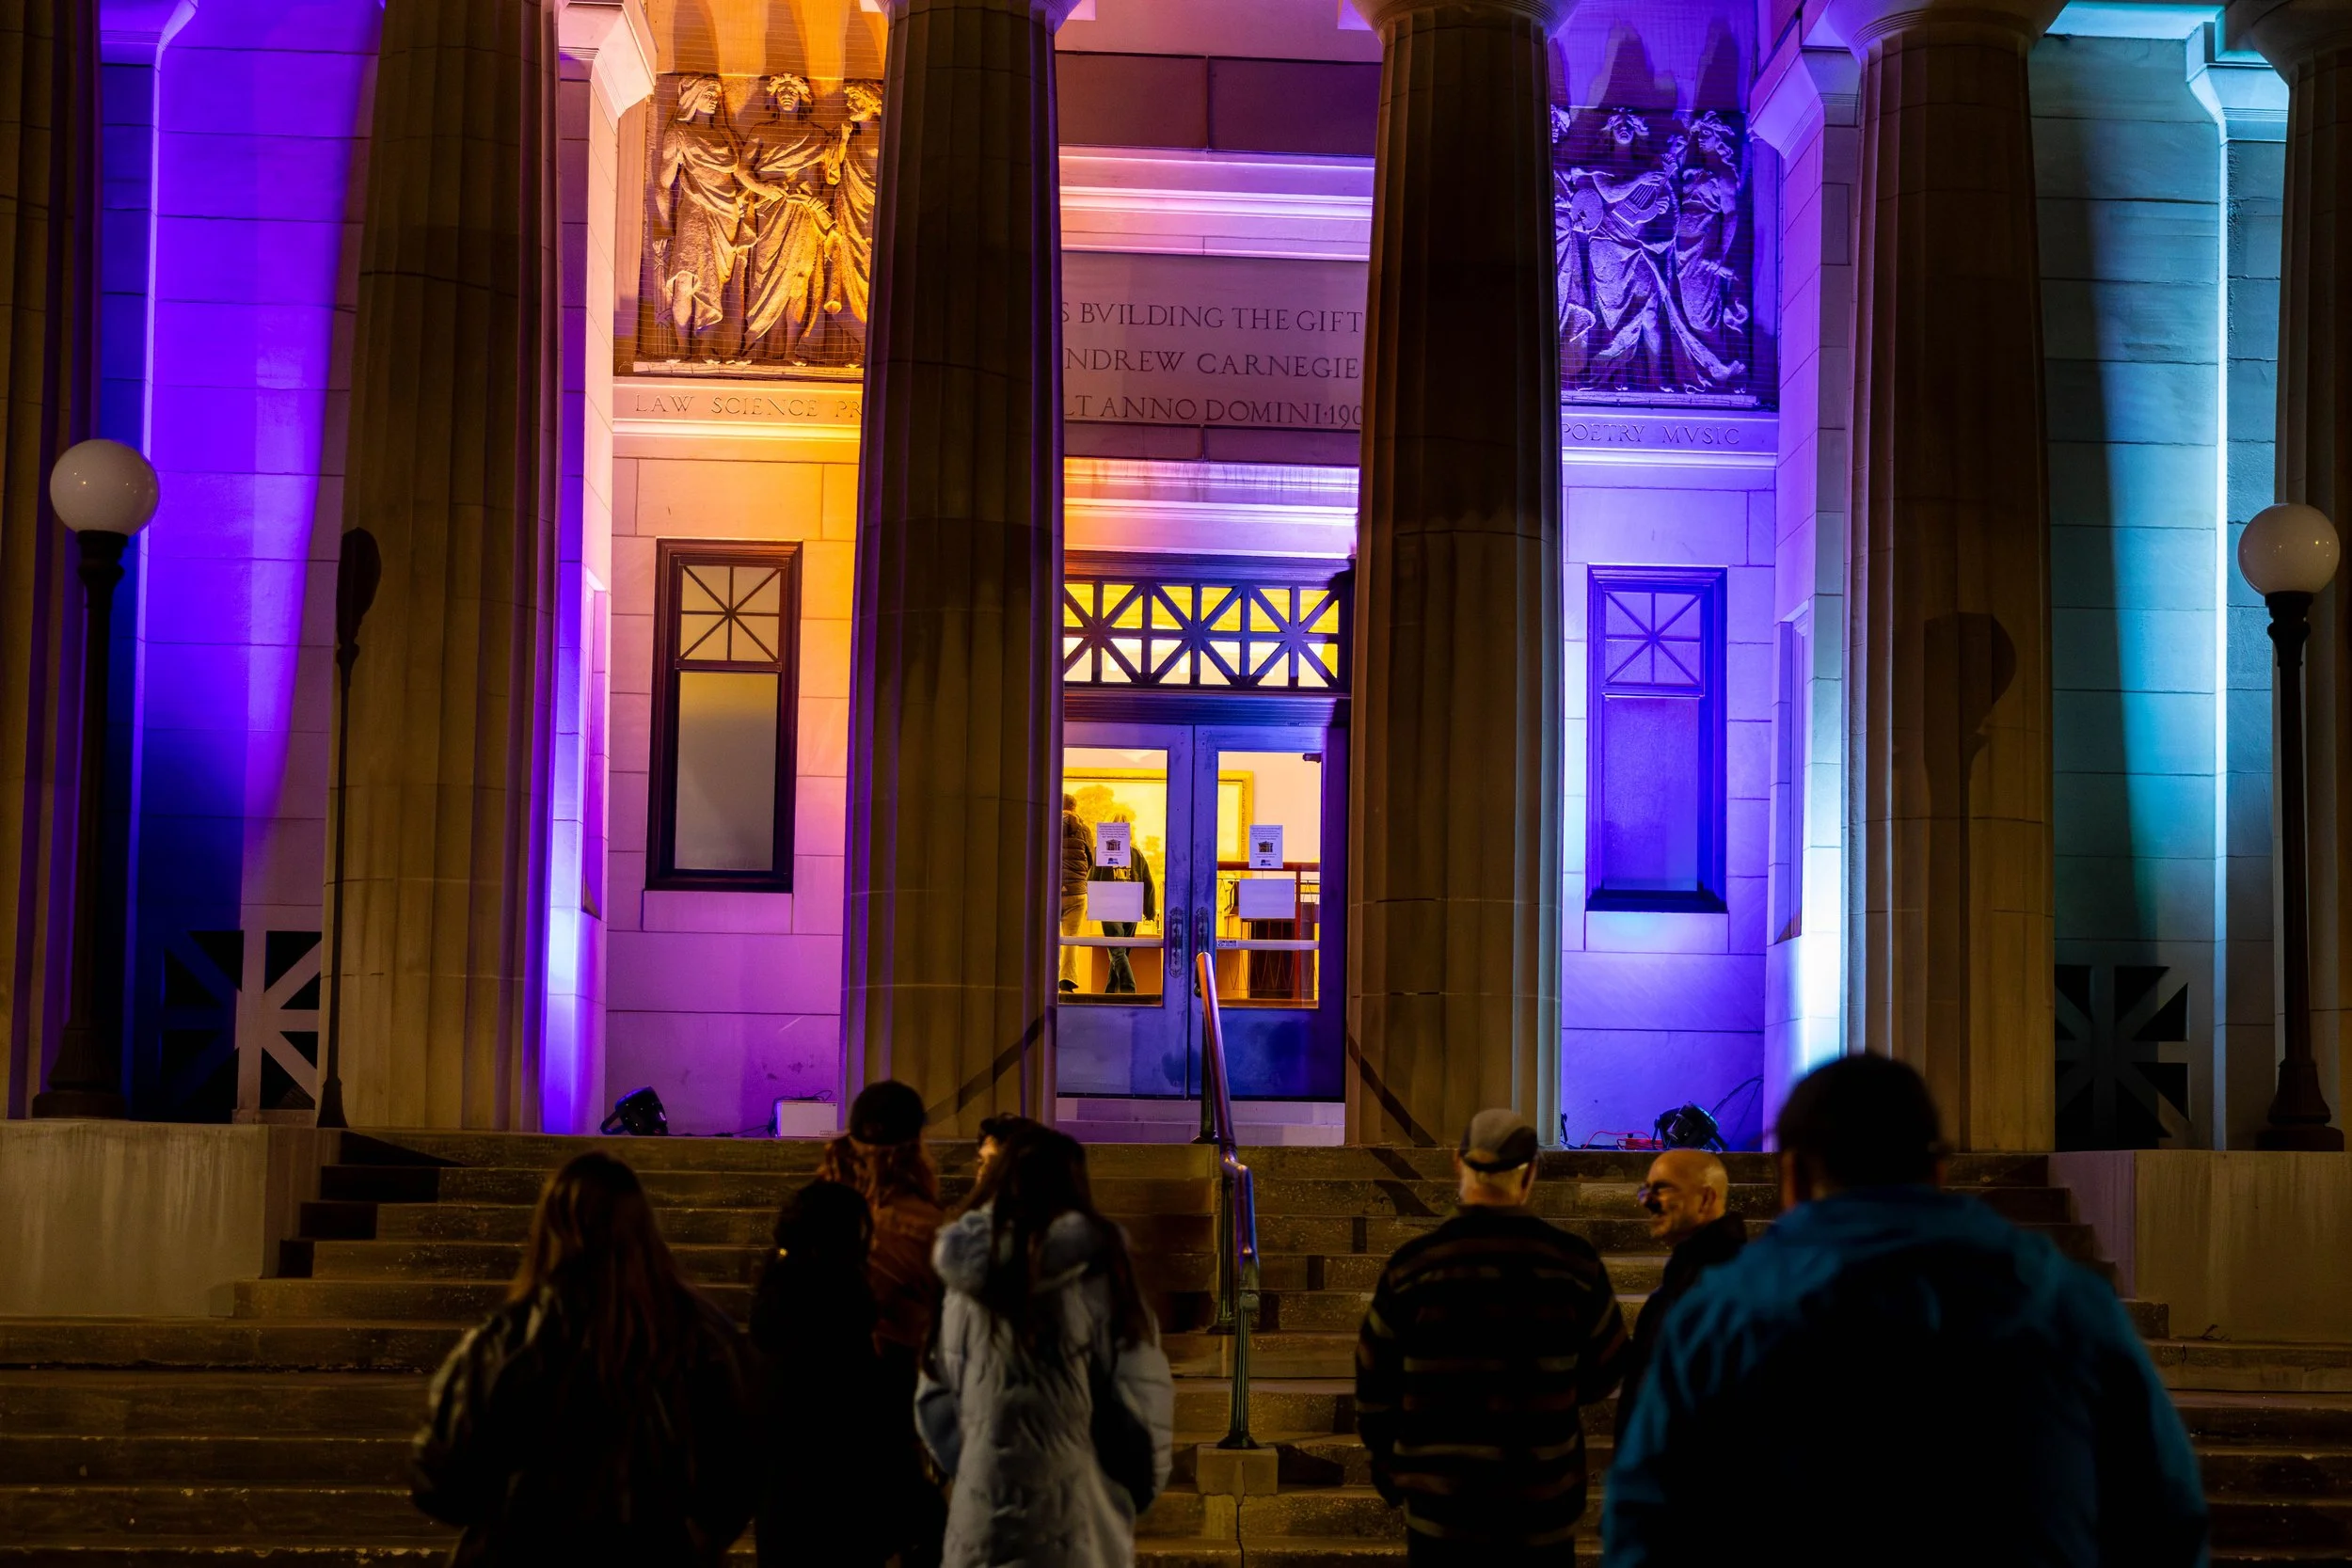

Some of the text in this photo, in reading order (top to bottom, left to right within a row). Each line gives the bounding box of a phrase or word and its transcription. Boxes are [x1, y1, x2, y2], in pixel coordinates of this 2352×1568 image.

[1079, 301, 1225, 329] BVILDING
[1232, 307, 1290, 330] THE
[1295, 309, 1363, 333] GIFT
[1197, 352, 1360, 380] CARNEGIE
[635, 394, 695, 413] LAW
[710, 396, 819, 418] SCIENCE
[1100, 395, 1198, 420] ANNO
[1661, 425, 1740, 446] MVSIC
